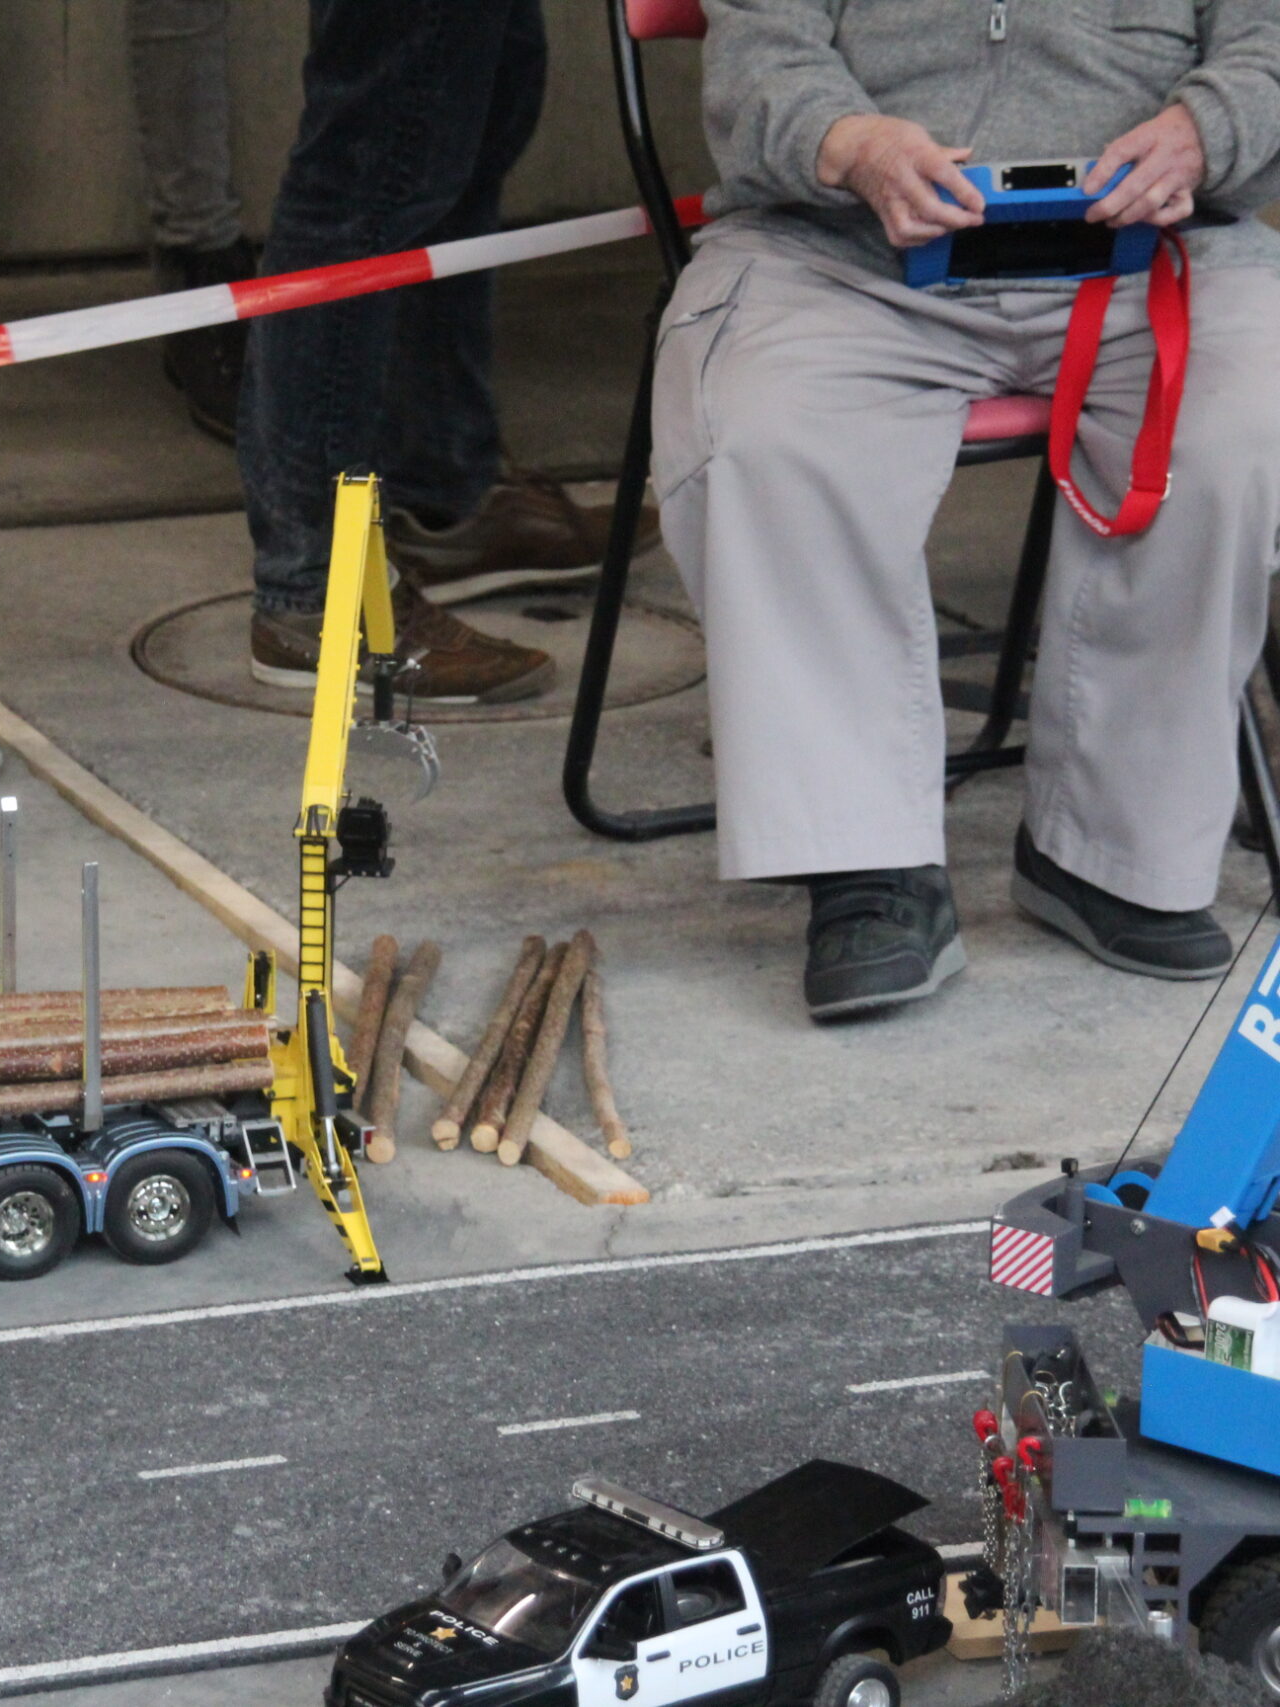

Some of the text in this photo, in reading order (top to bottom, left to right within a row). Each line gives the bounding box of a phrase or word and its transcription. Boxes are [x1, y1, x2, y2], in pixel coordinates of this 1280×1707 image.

[906, 1586, 936, 1605] CALL
[911, 1602, 930, 1620] 911
[429, 1610, 500, 1646] POLICE
[393, 1641, 424, 1657] SERVE
[679, 1640, 765, 1673] POLICE
